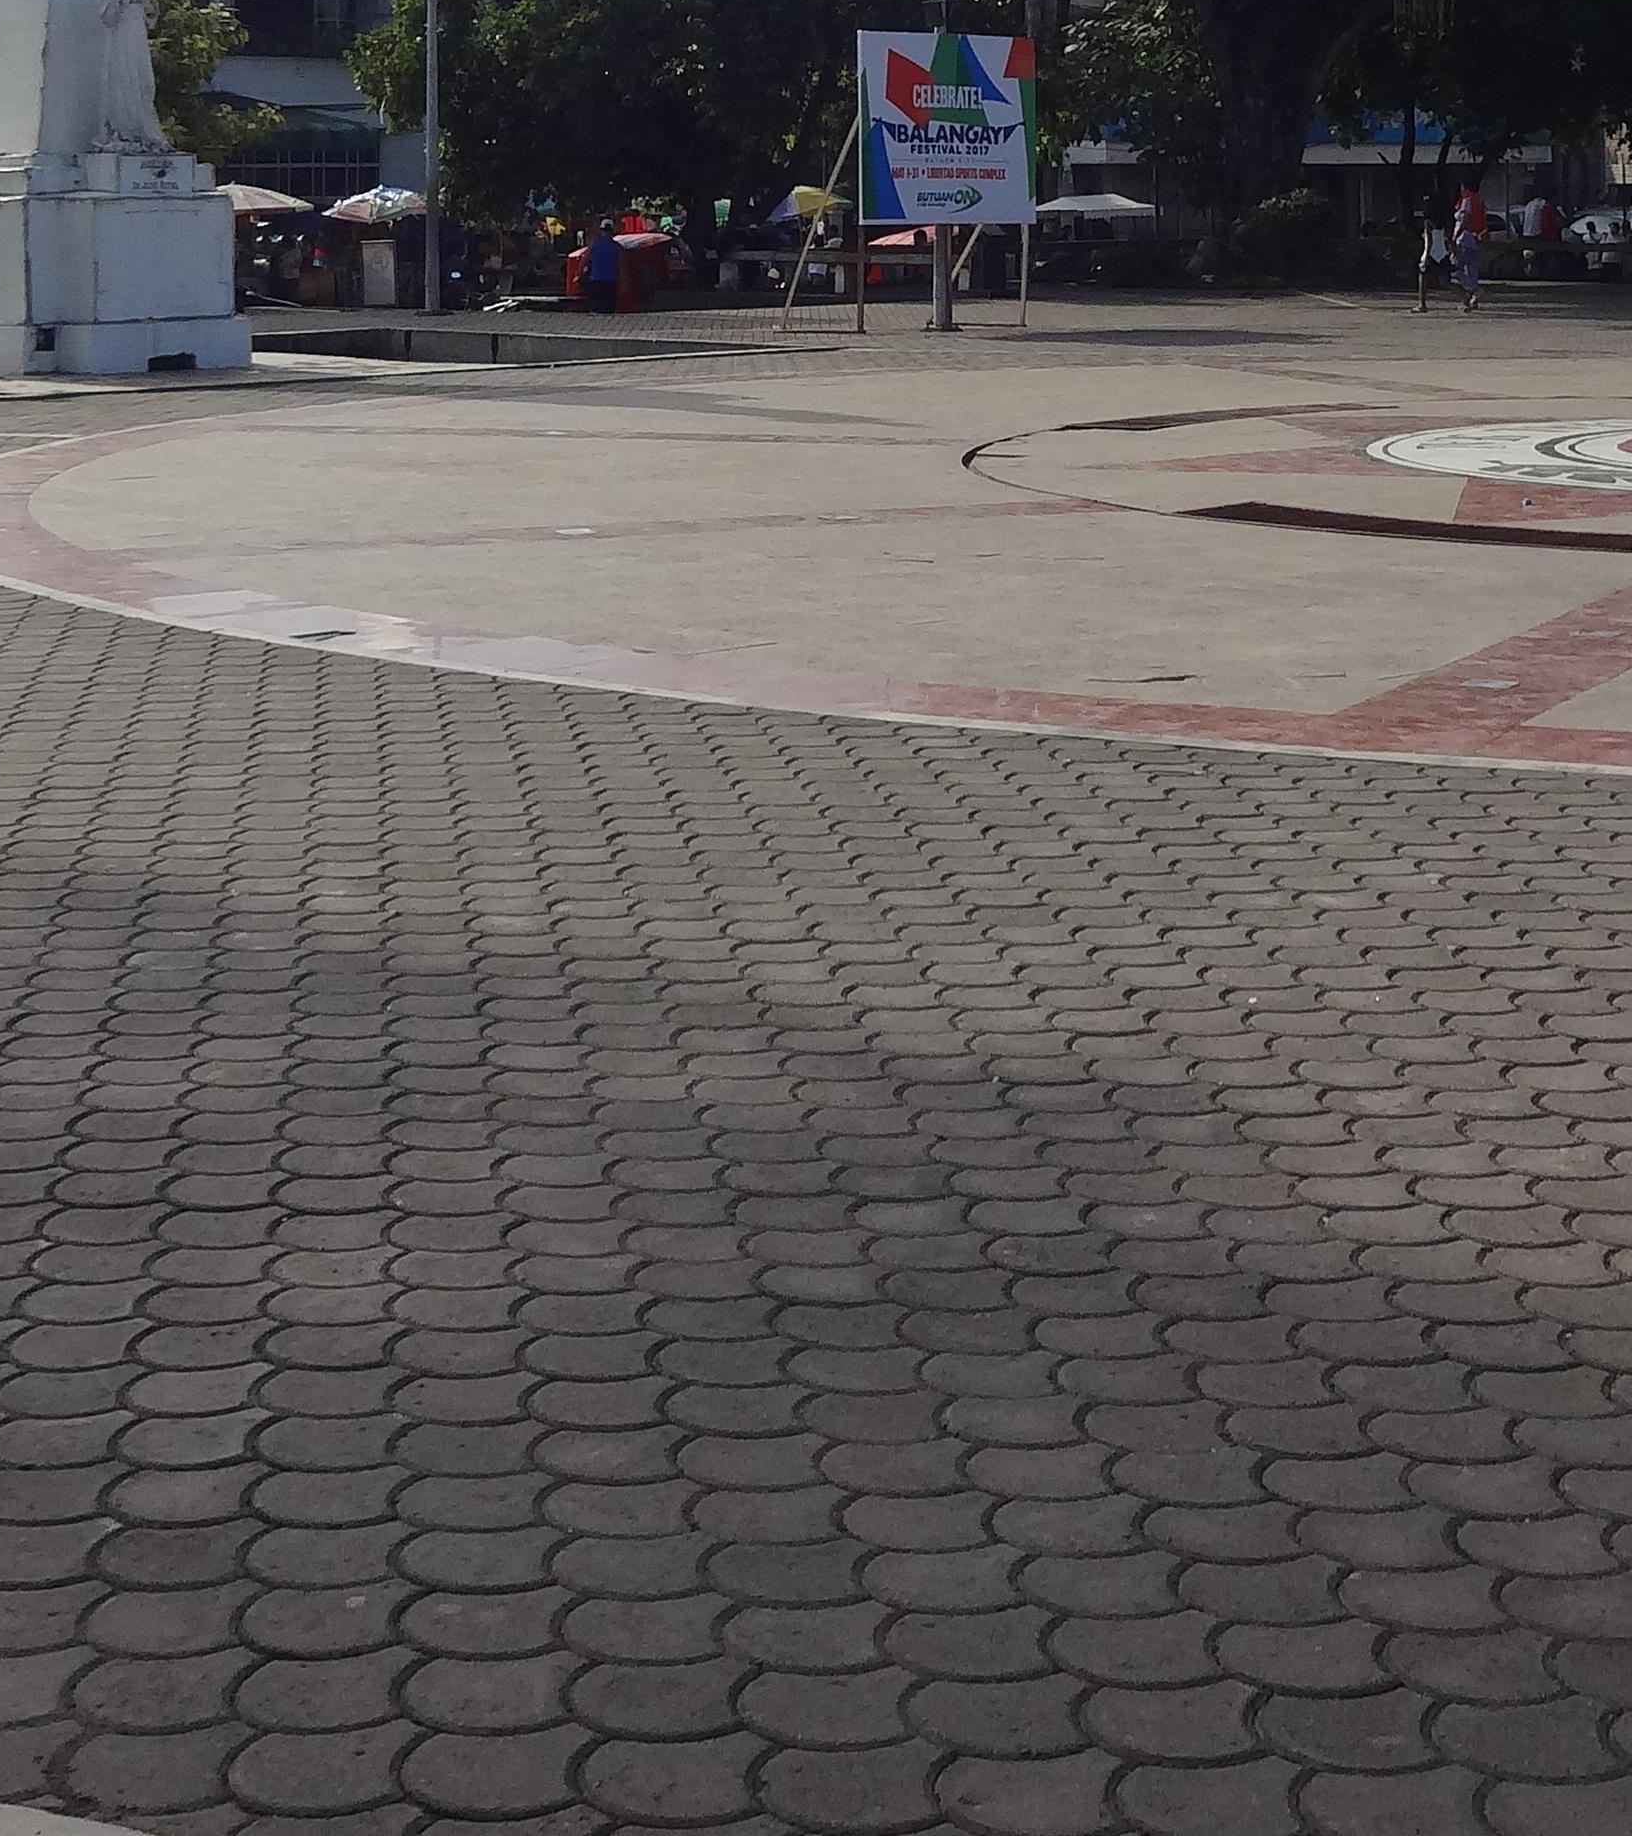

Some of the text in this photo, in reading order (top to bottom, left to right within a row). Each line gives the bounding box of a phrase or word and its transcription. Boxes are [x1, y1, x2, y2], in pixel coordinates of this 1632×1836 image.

[913, 84, 983, 109] CELEBRATE!
[896, 124, 1003, 145] BALANGAY
[910, 144, 990, 156] FESTIVAL 2017
